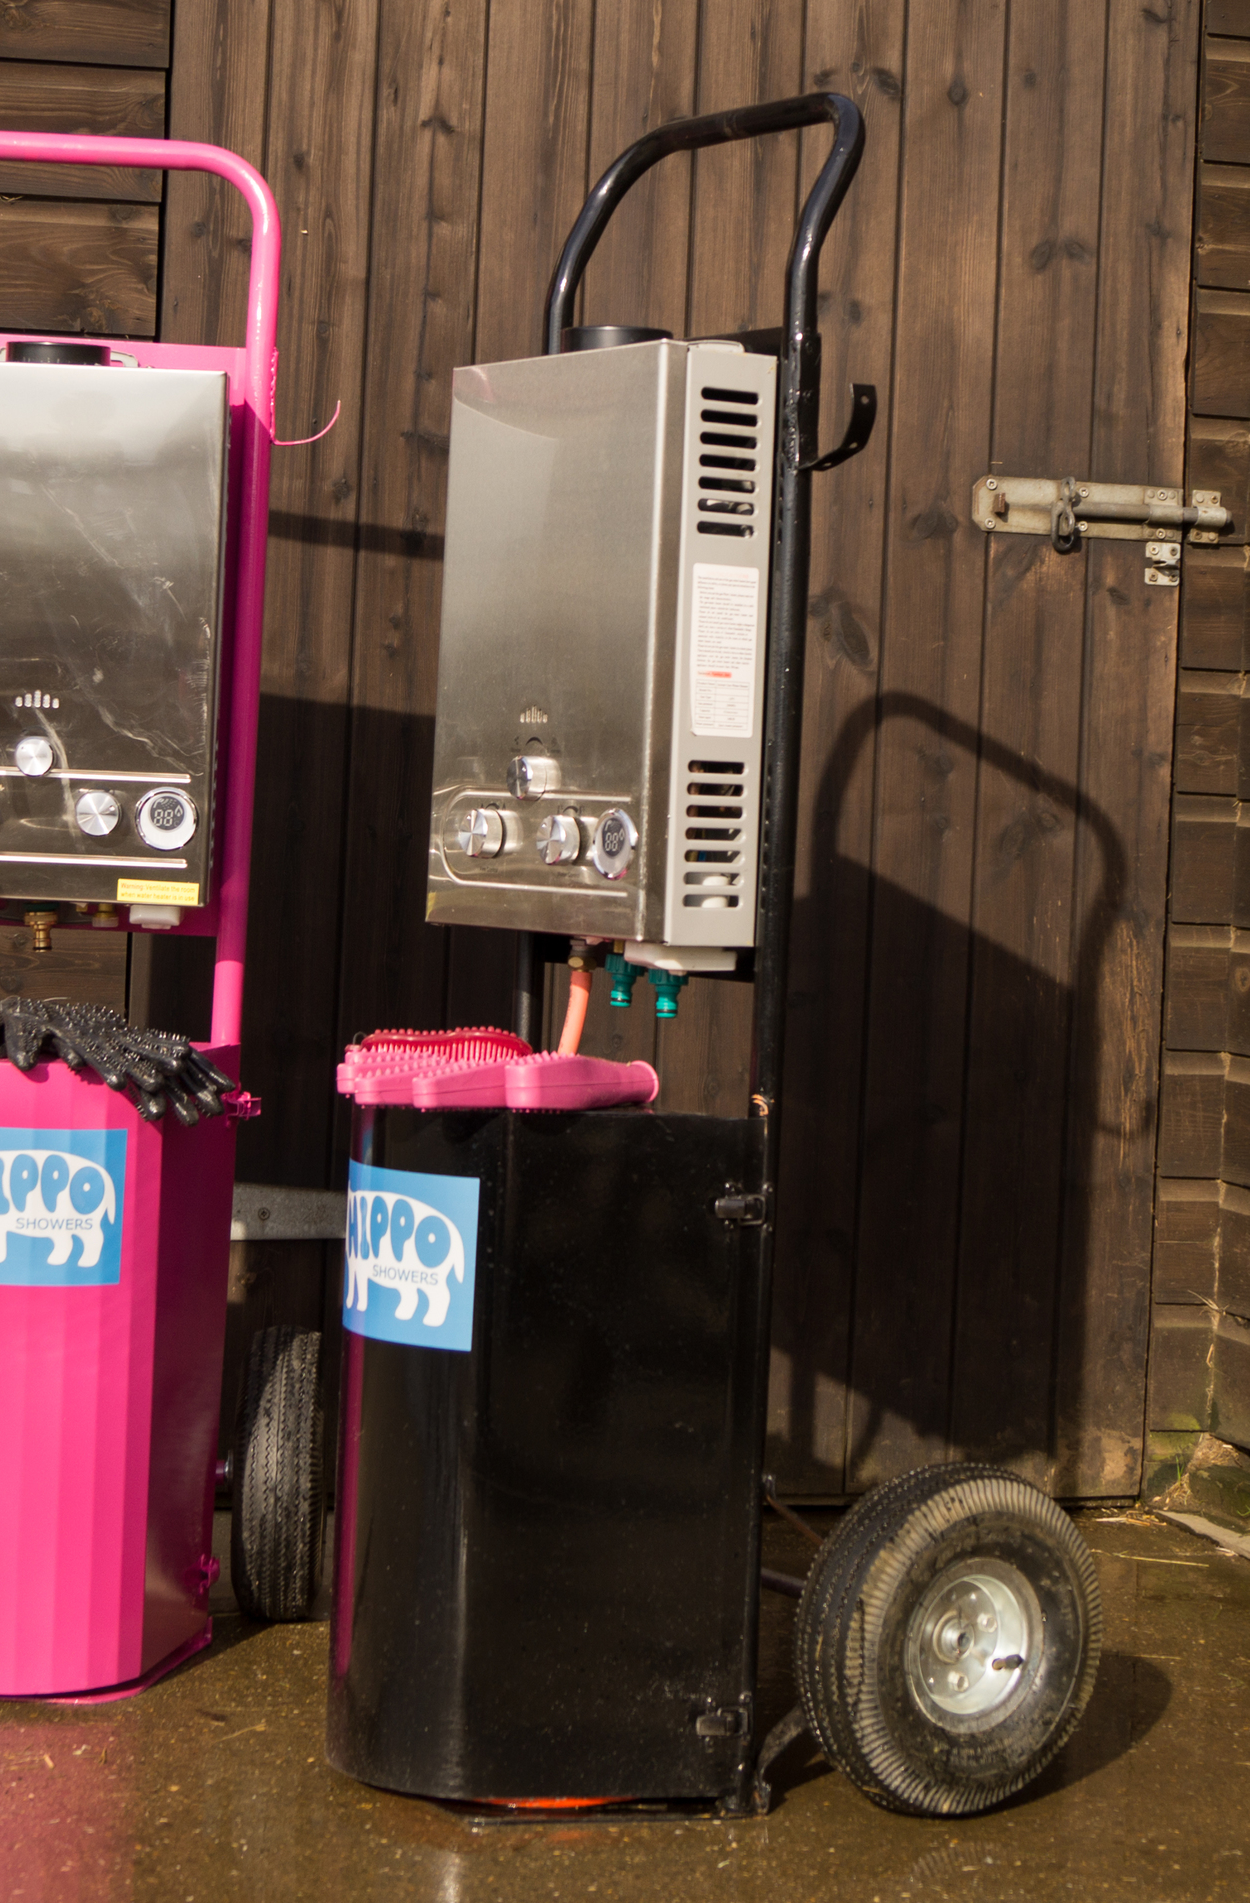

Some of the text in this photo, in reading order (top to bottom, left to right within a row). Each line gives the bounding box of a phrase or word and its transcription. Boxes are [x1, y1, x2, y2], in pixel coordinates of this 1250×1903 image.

[15, 1217, 94, 1231] SHOWERS
[348, 1194, 451, 1269] HIPPO
[372, 1263, 439, 1286] SHOWERS
